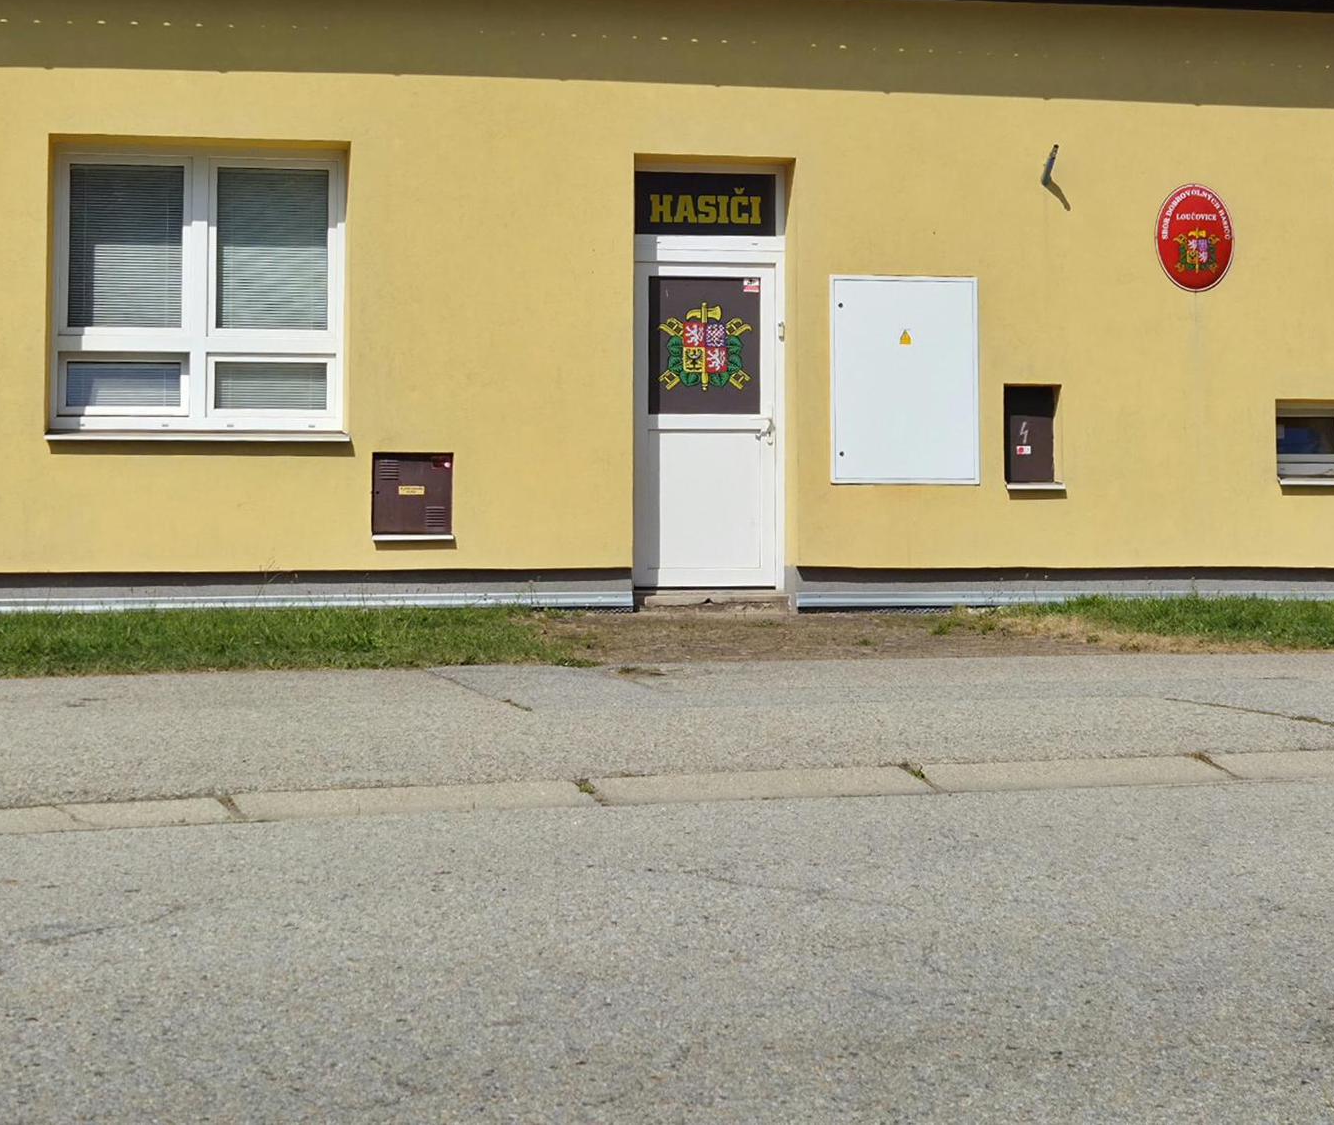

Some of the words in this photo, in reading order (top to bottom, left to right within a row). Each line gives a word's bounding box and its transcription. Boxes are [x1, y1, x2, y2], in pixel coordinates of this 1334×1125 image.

[650, 186, 762, 225] HASIČI
[1176, 212, 1217, 221] LOUČOVICE
[1162, 217, 1170, 239] SBOR
